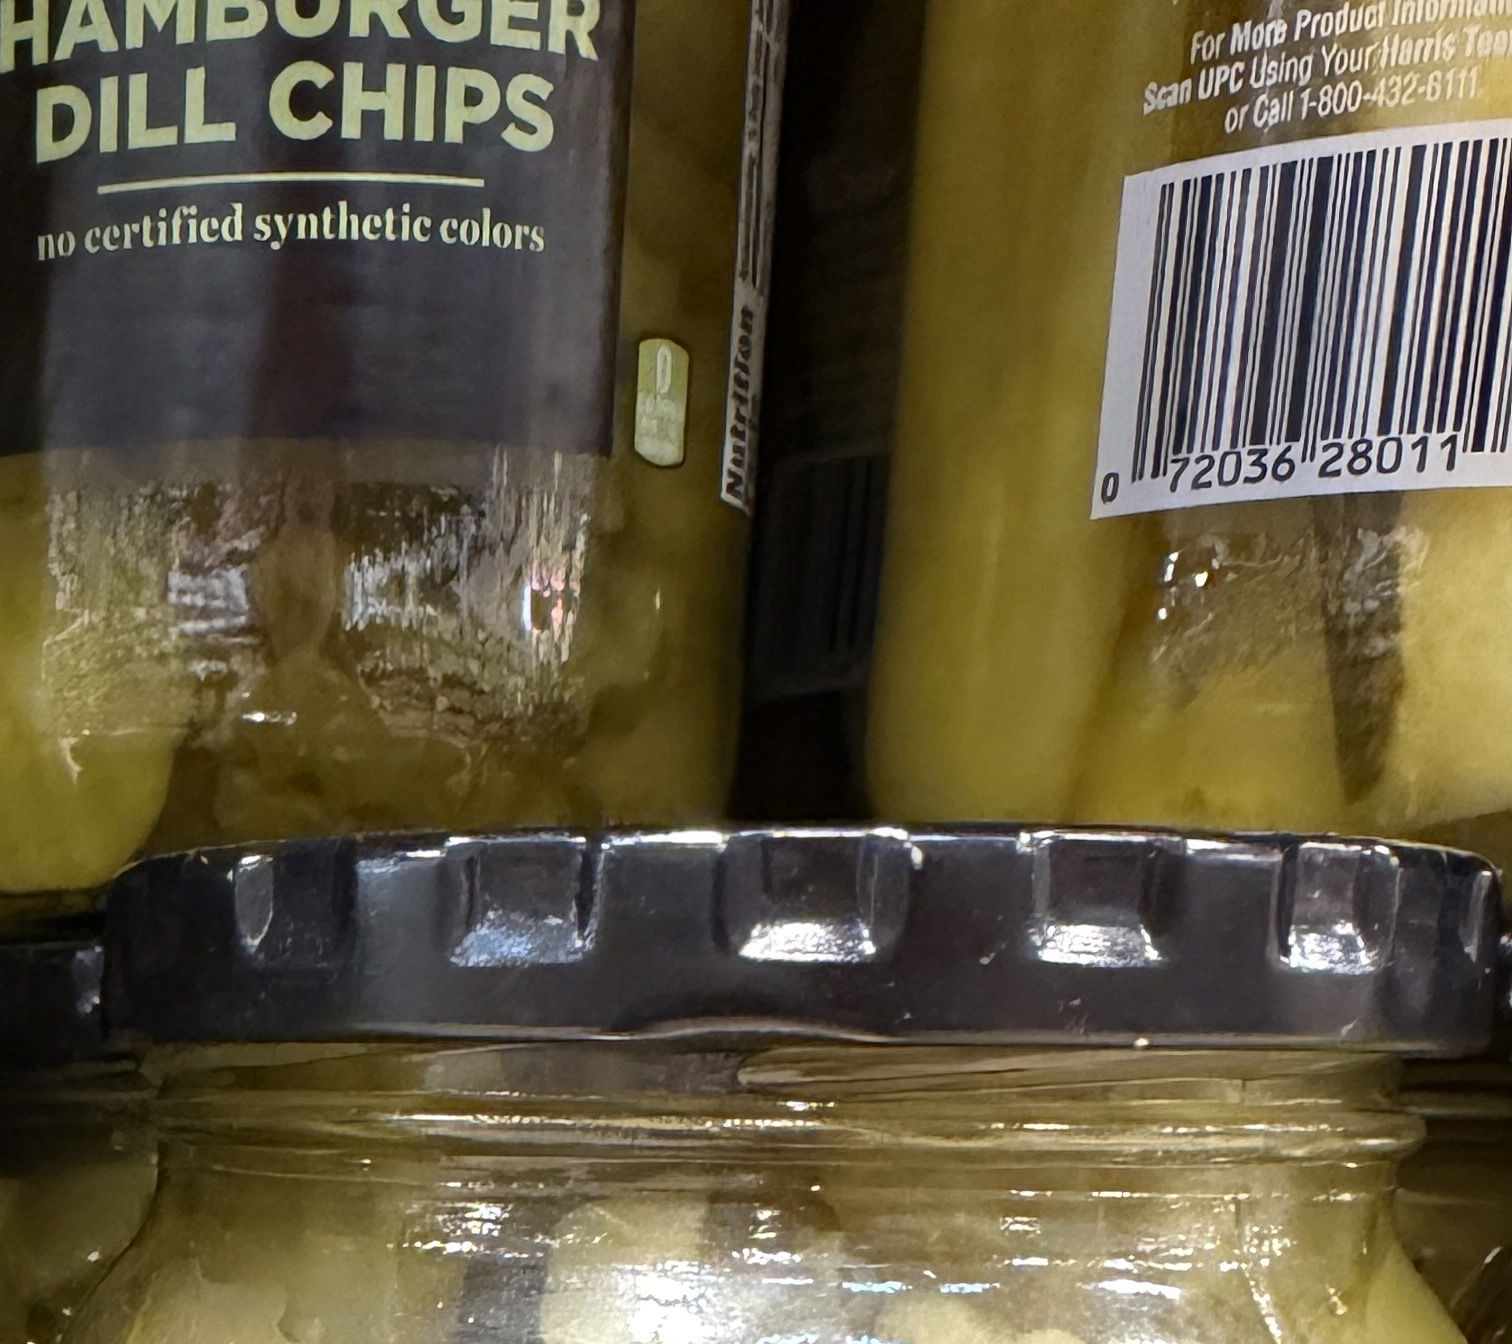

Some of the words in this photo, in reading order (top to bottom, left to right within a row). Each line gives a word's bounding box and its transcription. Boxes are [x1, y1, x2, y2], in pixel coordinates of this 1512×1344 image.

[1190, 31, 1226, 65] For
[1229, 16, 1287, 56] More
[1294, 2, 1386, 42] Product
[1143, 77, 1193, 116] Scan
[1197, 56, 1245, 101] UPC
[1249, 51, 1313, 90] Using
[1320, 43, 1378, 77] Your
[1378, 33, 1456, 67] Harris
[1224, 106, 1246, 135] or
[1252, 92, 1293, 129] Call
[1300, 65, 1482, 121] 1-800-432-6111
[36, 68, 237, 165] DILL
[268, 60, 555, 153] CHIPS
[37, 228, 76, 262] no
[84, 203, 244, 255] certified
[253, 201, 432, 252] synthetic
[439, 207, 546, 255] colors
[1100, 472, 1120, 503] 0
[1168, 443, 1296, 493] 72036
[1317, 433, 1460, 480] 28011
